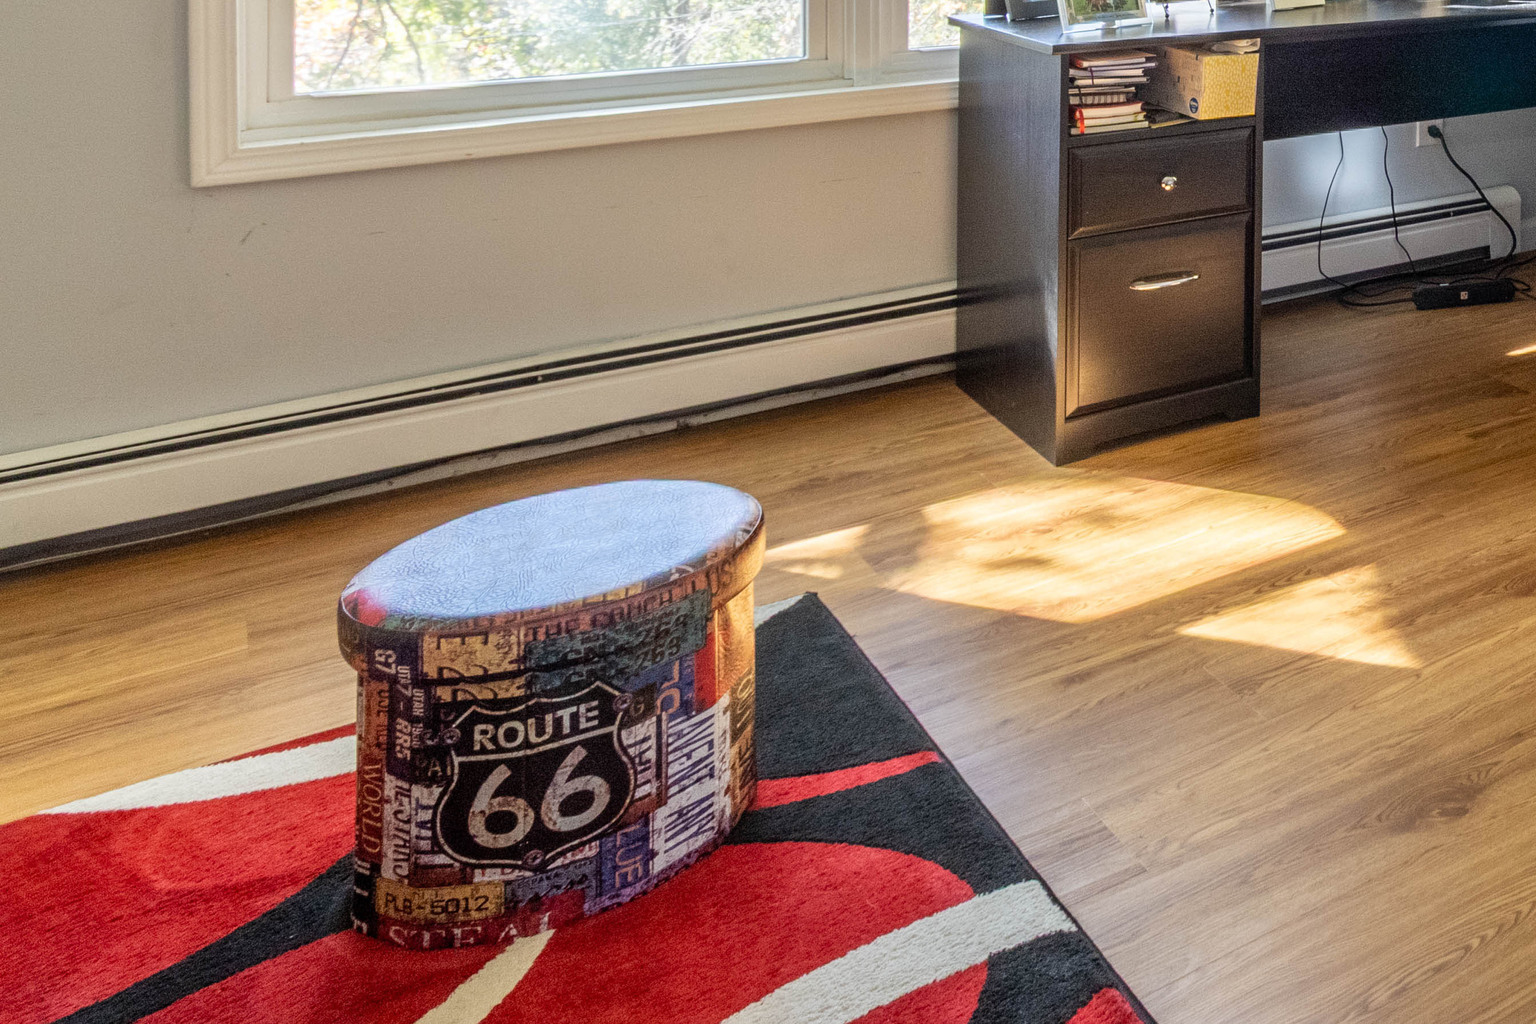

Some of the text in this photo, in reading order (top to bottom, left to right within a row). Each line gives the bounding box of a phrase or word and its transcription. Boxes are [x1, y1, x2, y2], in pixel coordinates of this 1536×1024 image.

[472, 699, 602, 752] ROUTE
[361, 762, 383, 854] WORLD
[468, 744, 613, 850] 66
[663, 790, 716, 855] ANY
